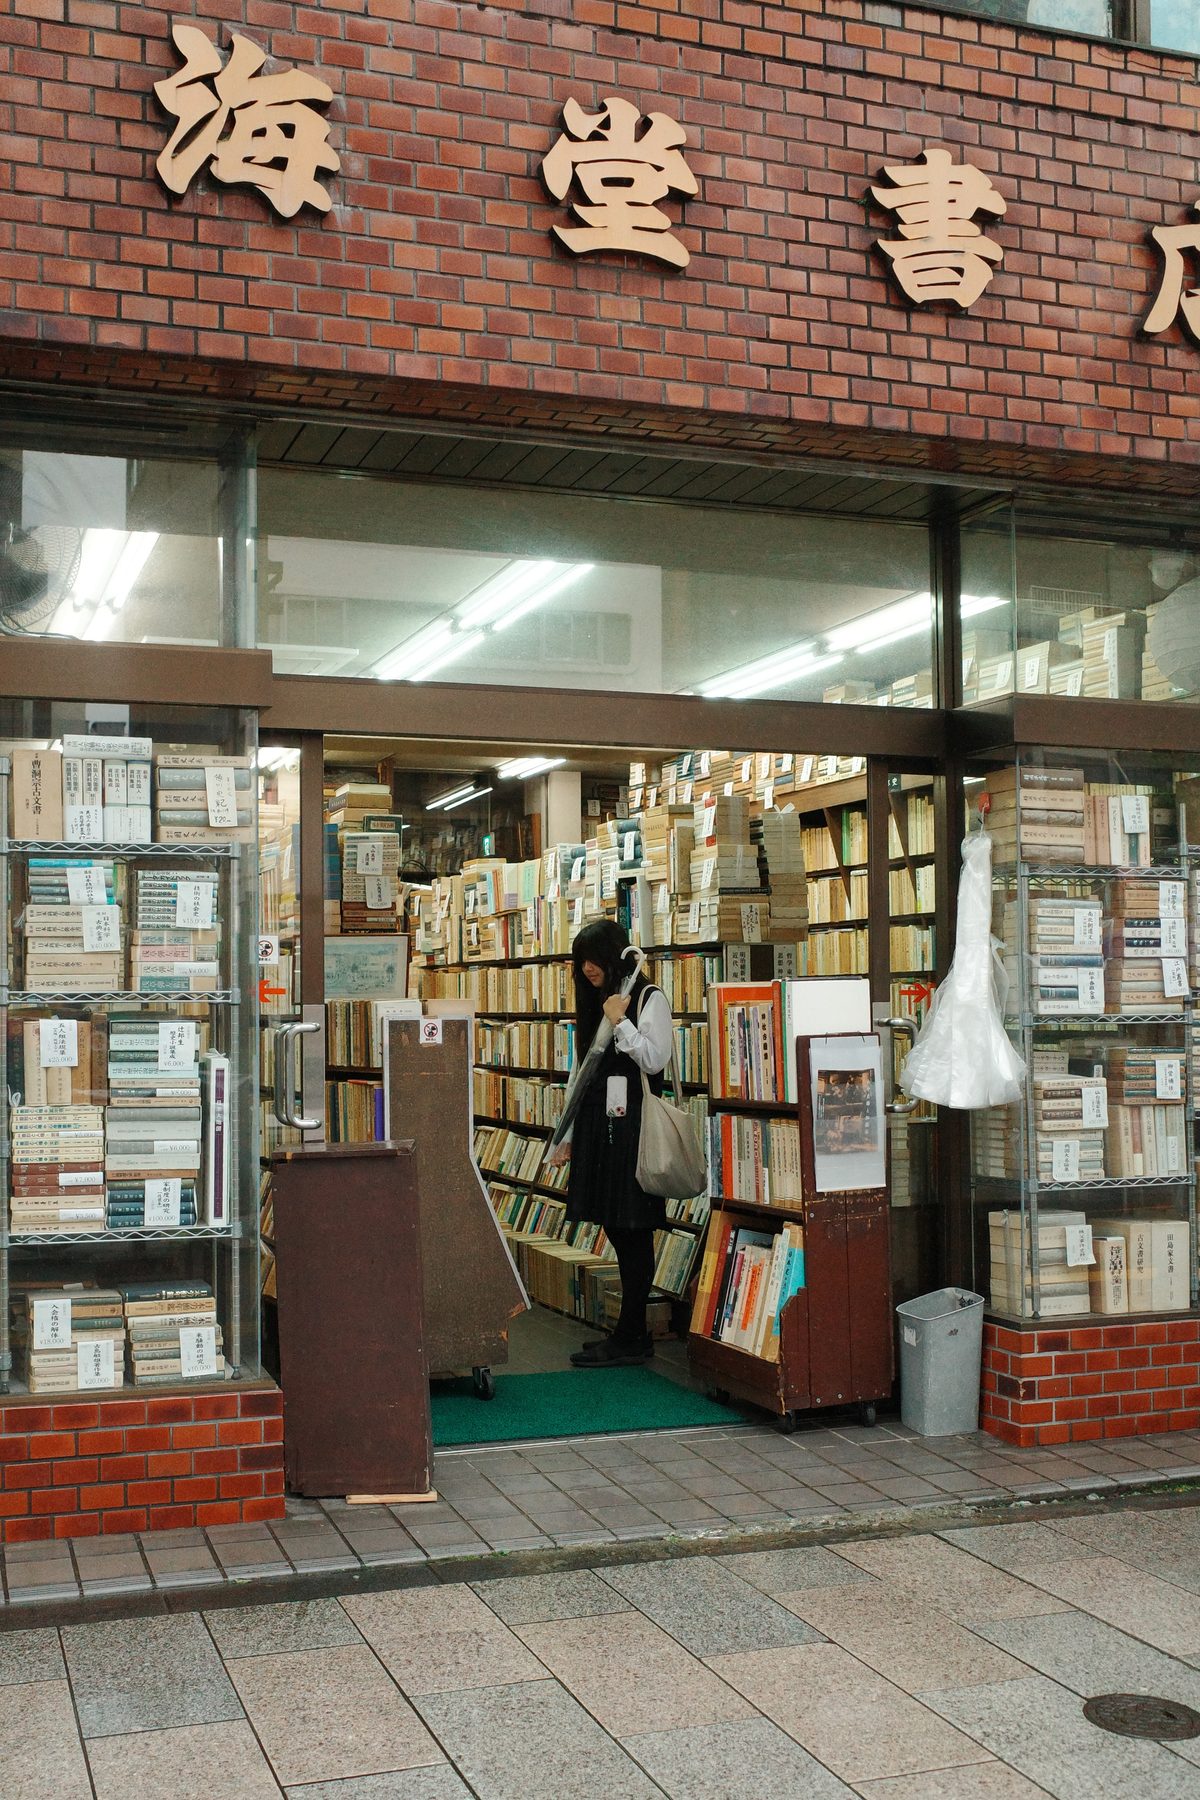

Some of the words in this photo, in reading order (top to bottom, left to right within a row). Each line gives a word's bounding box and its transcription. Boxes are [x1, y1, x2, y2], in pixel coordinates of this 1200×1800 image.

[32, 760, 42, 815] 曹洞宗古文書
[732, 951, 738, 967] 近代
[1174, 961, 1183, 987] 江戸叢書
[58, 1023, 66, 1055] 五人組法規集
[177, 1026, 185, 1046] 辻邦生
[729, 1011, 737, 1066] 日本の船絵馬
[20, 1163, 65, 1173] 明月記
[21, 1186, 66, 1196] 明月記
[162, 1181, 171, 1214] 家制度の研究
[50, 1304, 59, 1338] 入会権の解体
[166, 1301, 213, 1312] 日本労働年鑑
[168, 1315, 212, 1326] 日本労働年鑑
[93, 1343, 101, 1377] 古島敏雄著作集
[195, 1332, 204, 1365] 米騒動の研究
